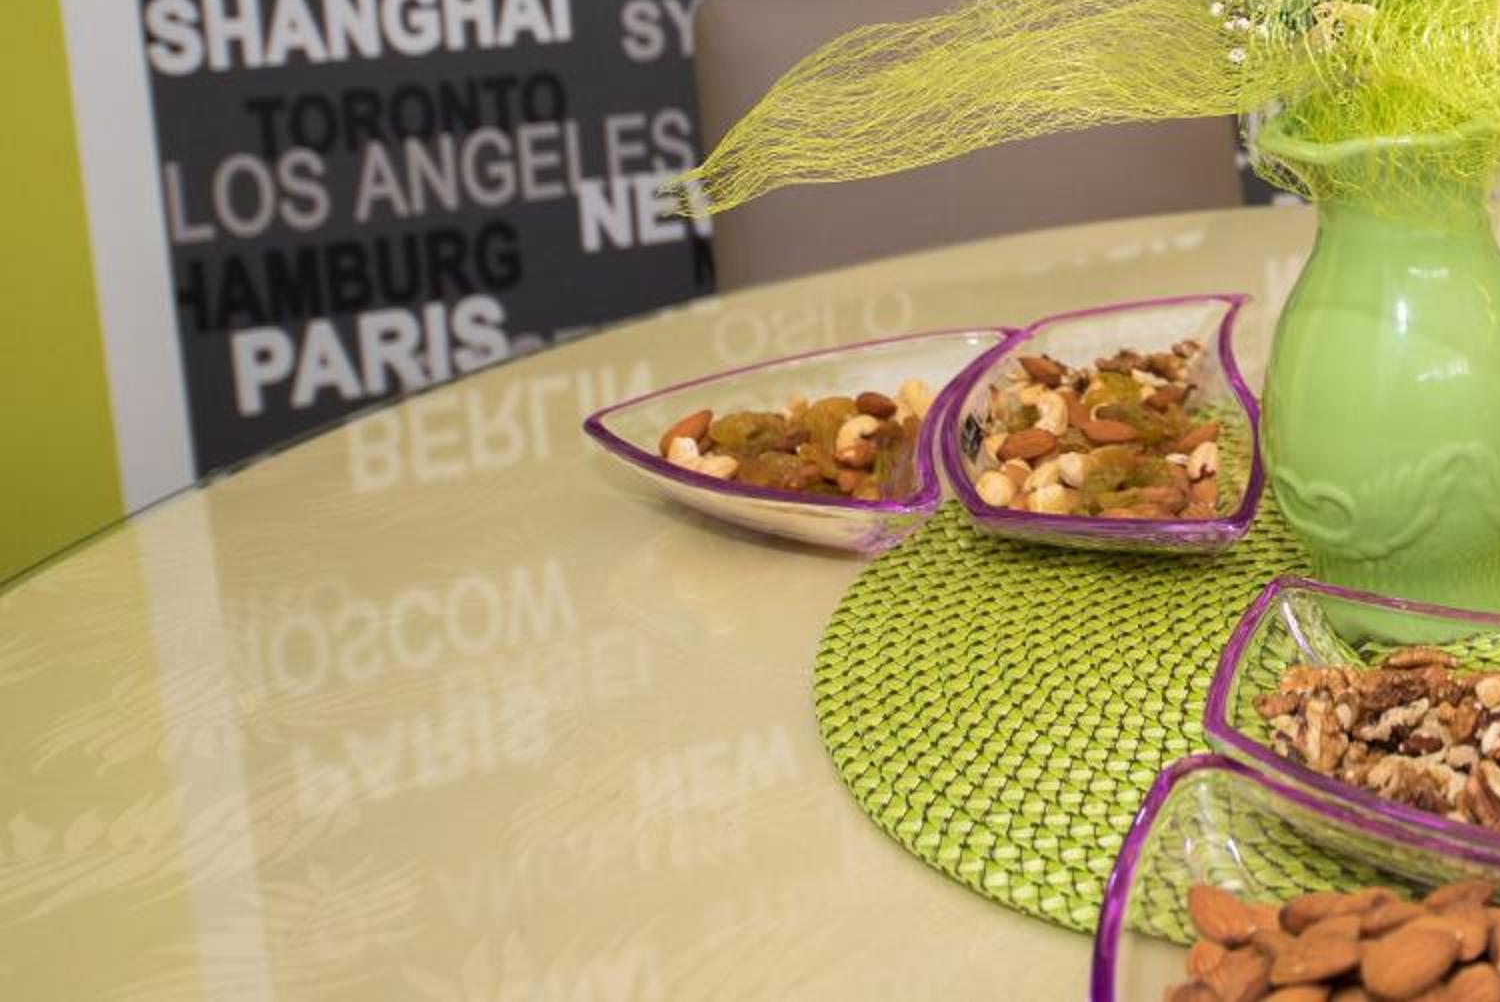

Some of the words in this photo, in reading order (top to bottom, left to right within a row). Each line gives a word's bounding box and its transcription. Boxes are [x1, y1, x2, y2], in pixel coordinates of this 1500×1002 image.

[245, 71, 567, 160] TORONTO
[163, 146, 331, 244] LOS
[353, 108, 697, 223] ANGELES
[178, 220, 524, 334] HAMBURG
[230, 295, 510, 416] PARIS
